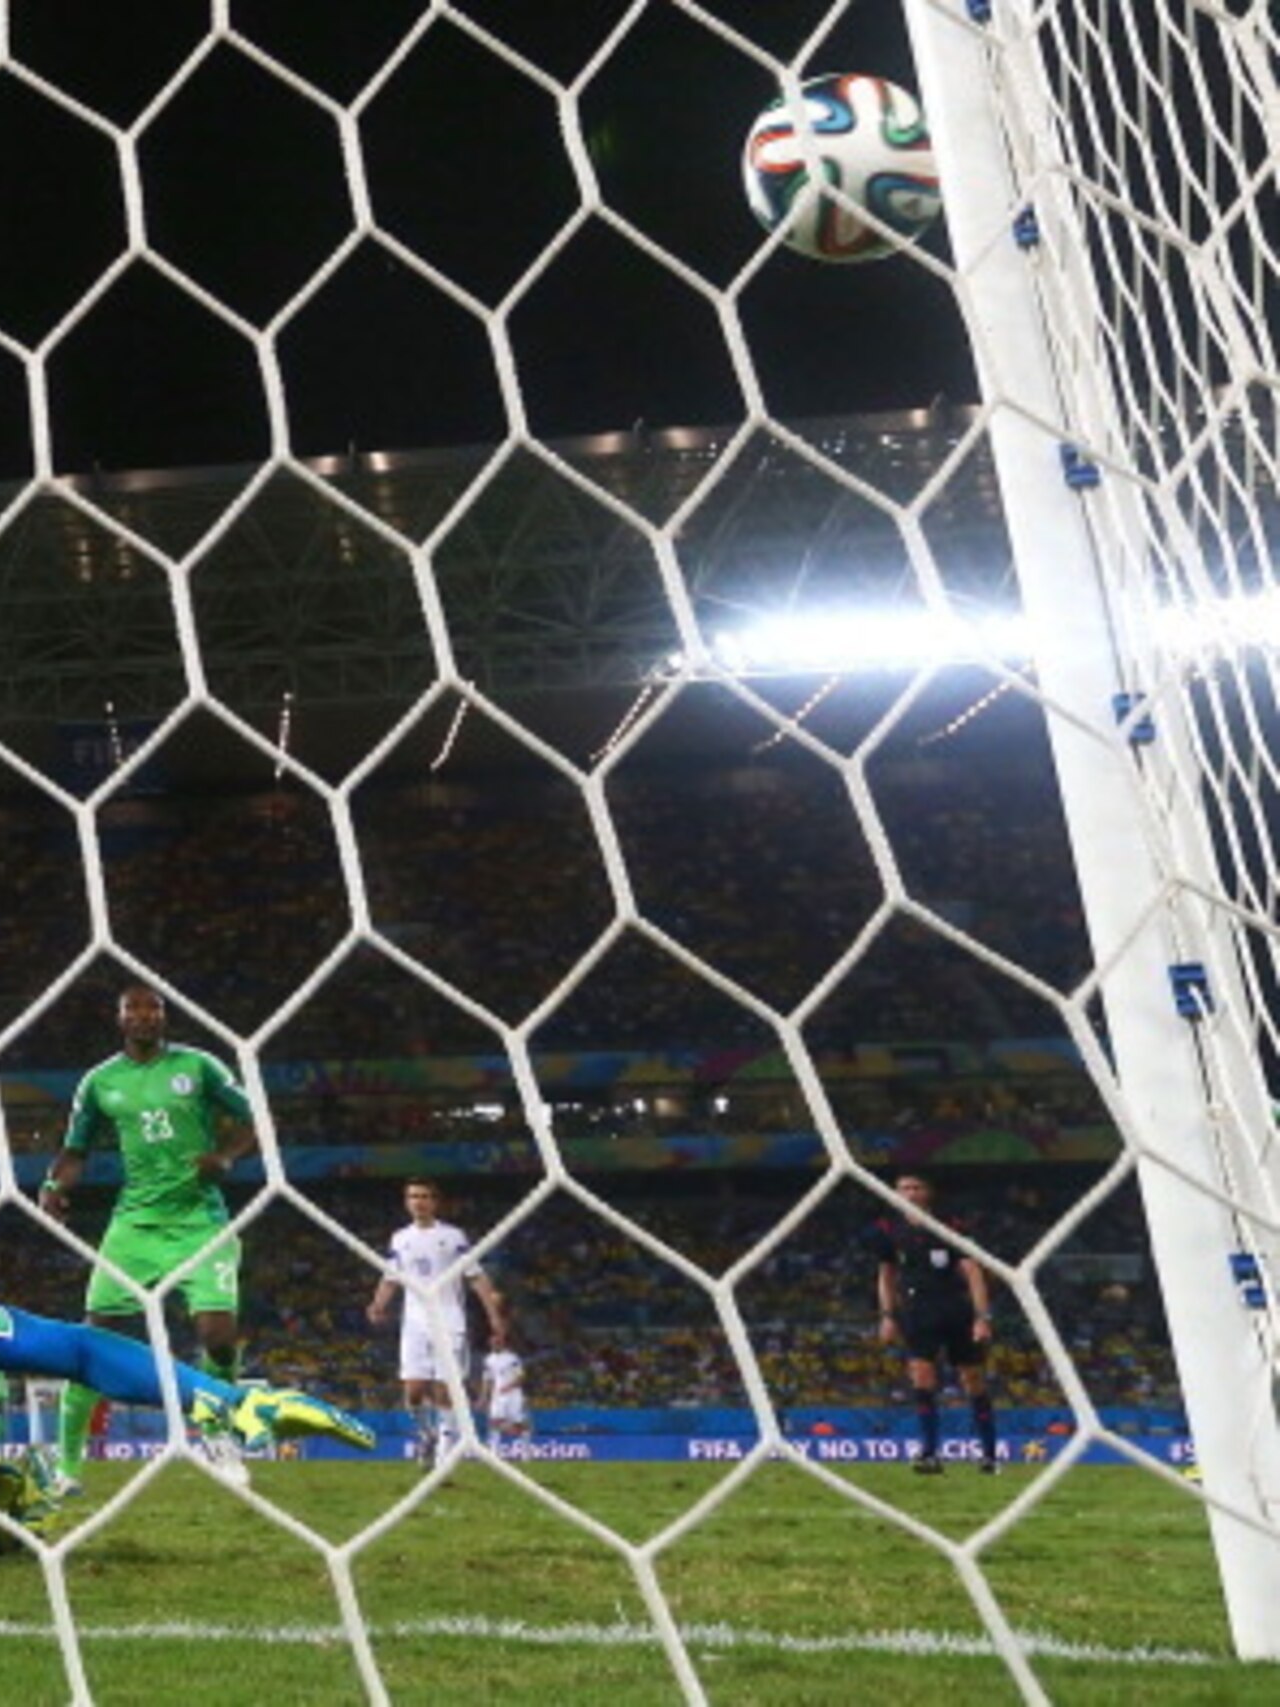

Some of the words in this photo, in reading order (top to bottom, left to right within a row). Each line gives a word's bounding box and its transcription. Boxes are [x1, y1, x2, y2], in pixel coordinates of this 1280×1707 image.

[140, 1109, 174, 1142] 23
[688, 1440, 742, 1459] FIFA
[818, 1440, 859, 1459] NO
[862, 1440, 898, 1459] TO
